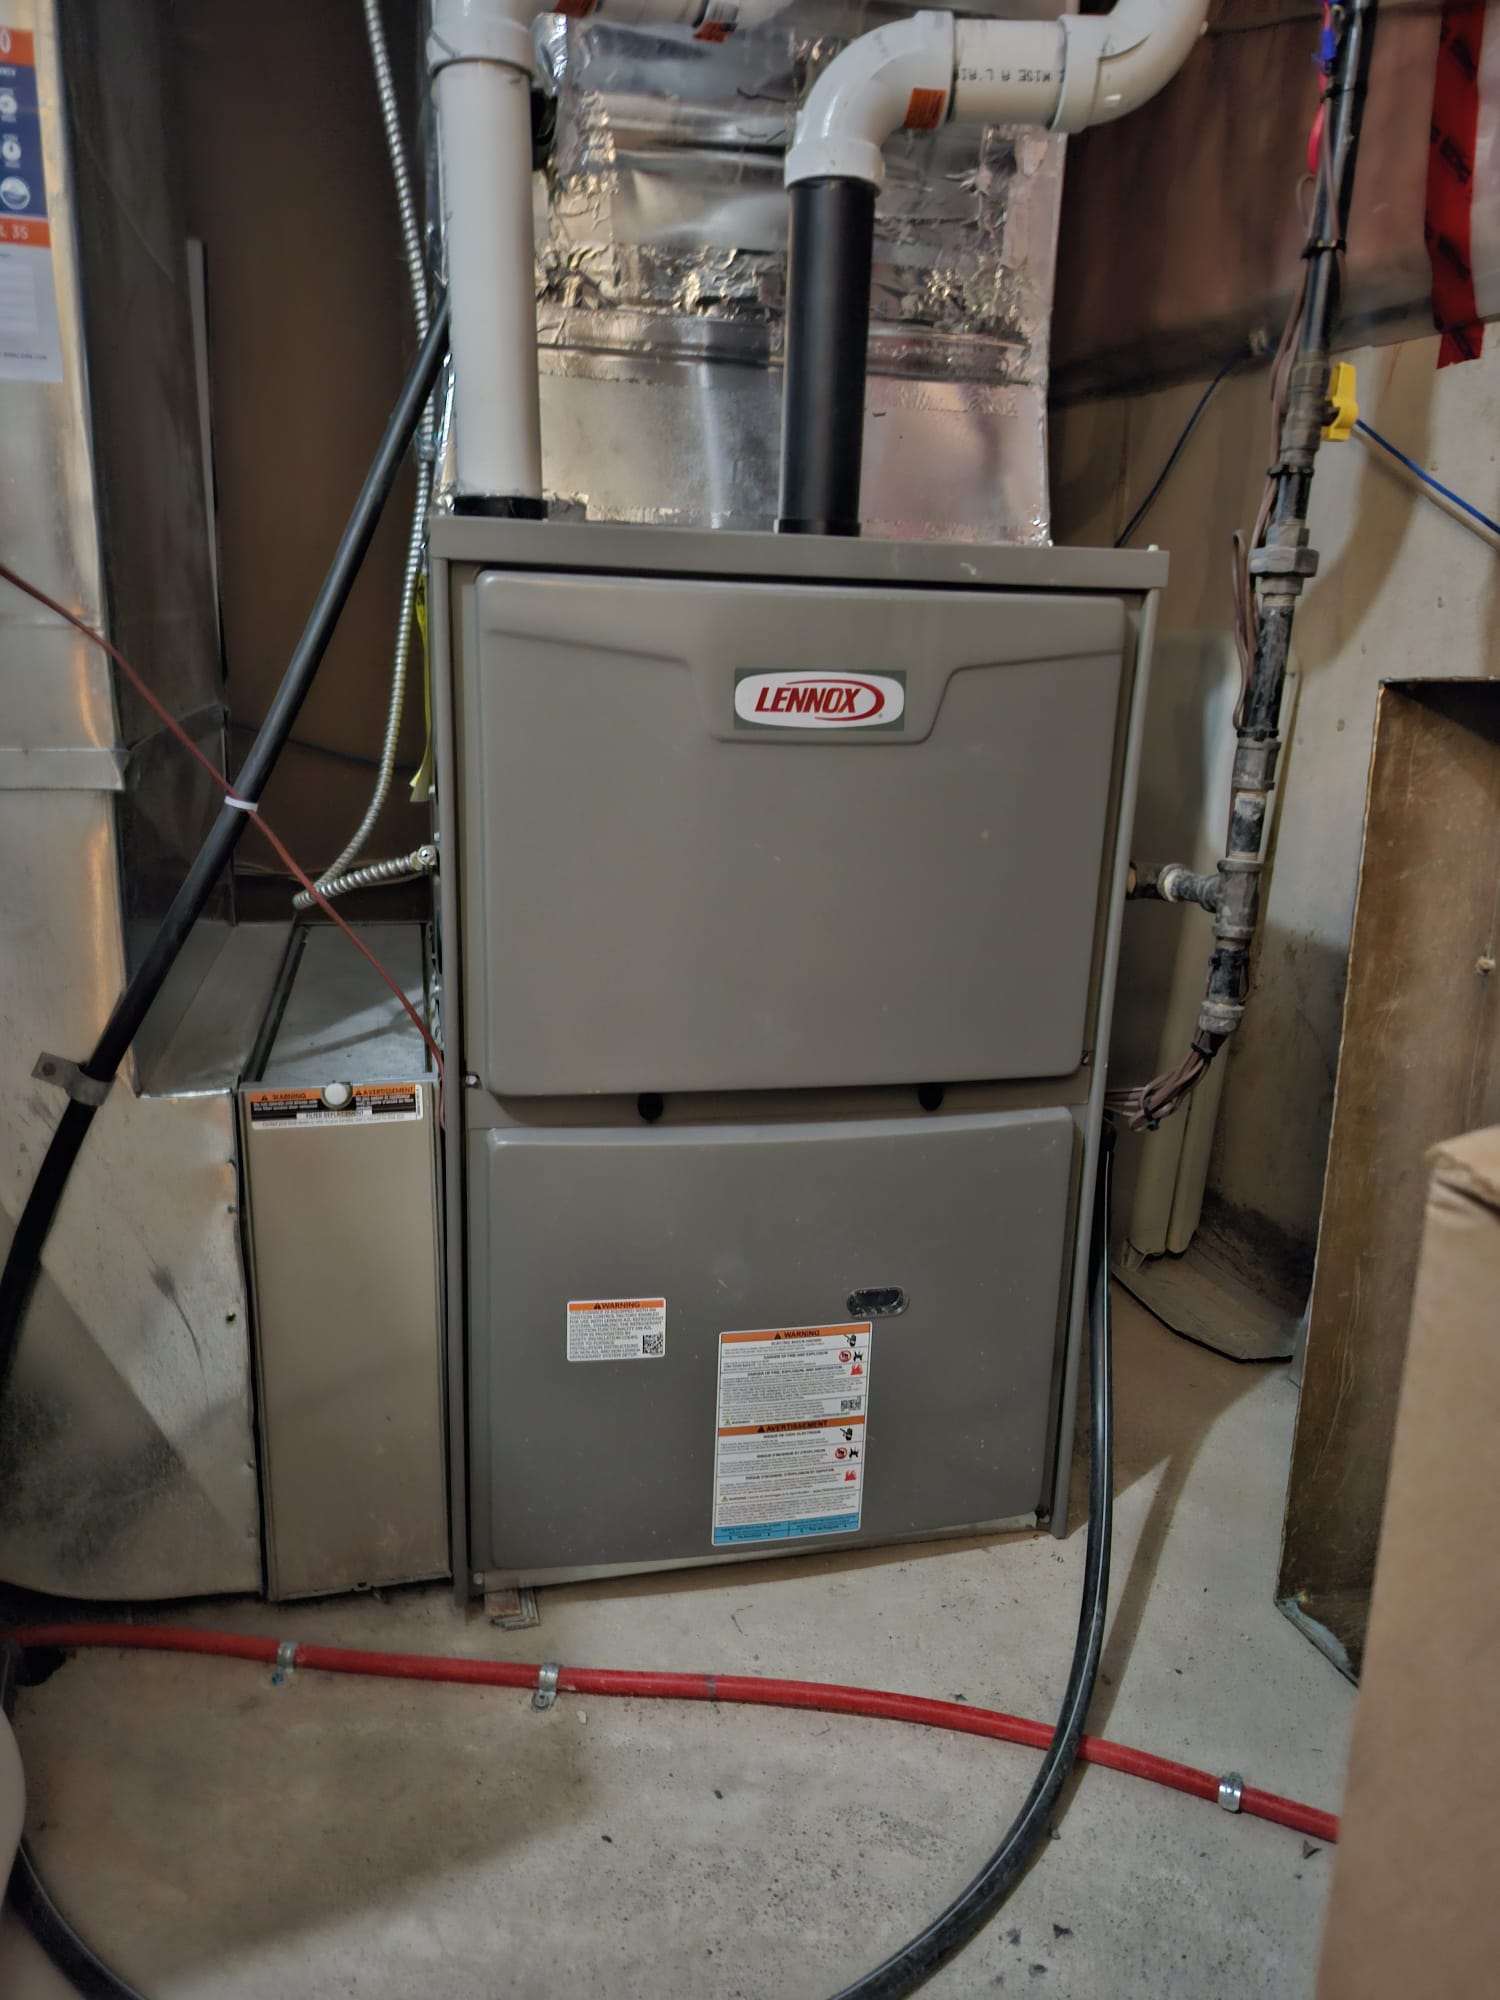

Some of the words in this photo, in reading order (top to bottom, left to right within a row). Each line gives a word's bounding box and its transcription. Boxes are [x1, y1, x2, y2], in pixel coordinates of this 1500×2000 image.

[754, 687, 862, 714] LENNOX
[272, 1092, 307, 1100] WARNING
[602, 1301, 640, 1309] WARNING
[784, 1328, 819, 1338] WARNING
[766, 1420, 827, 1432] AVERTISSEMENT
